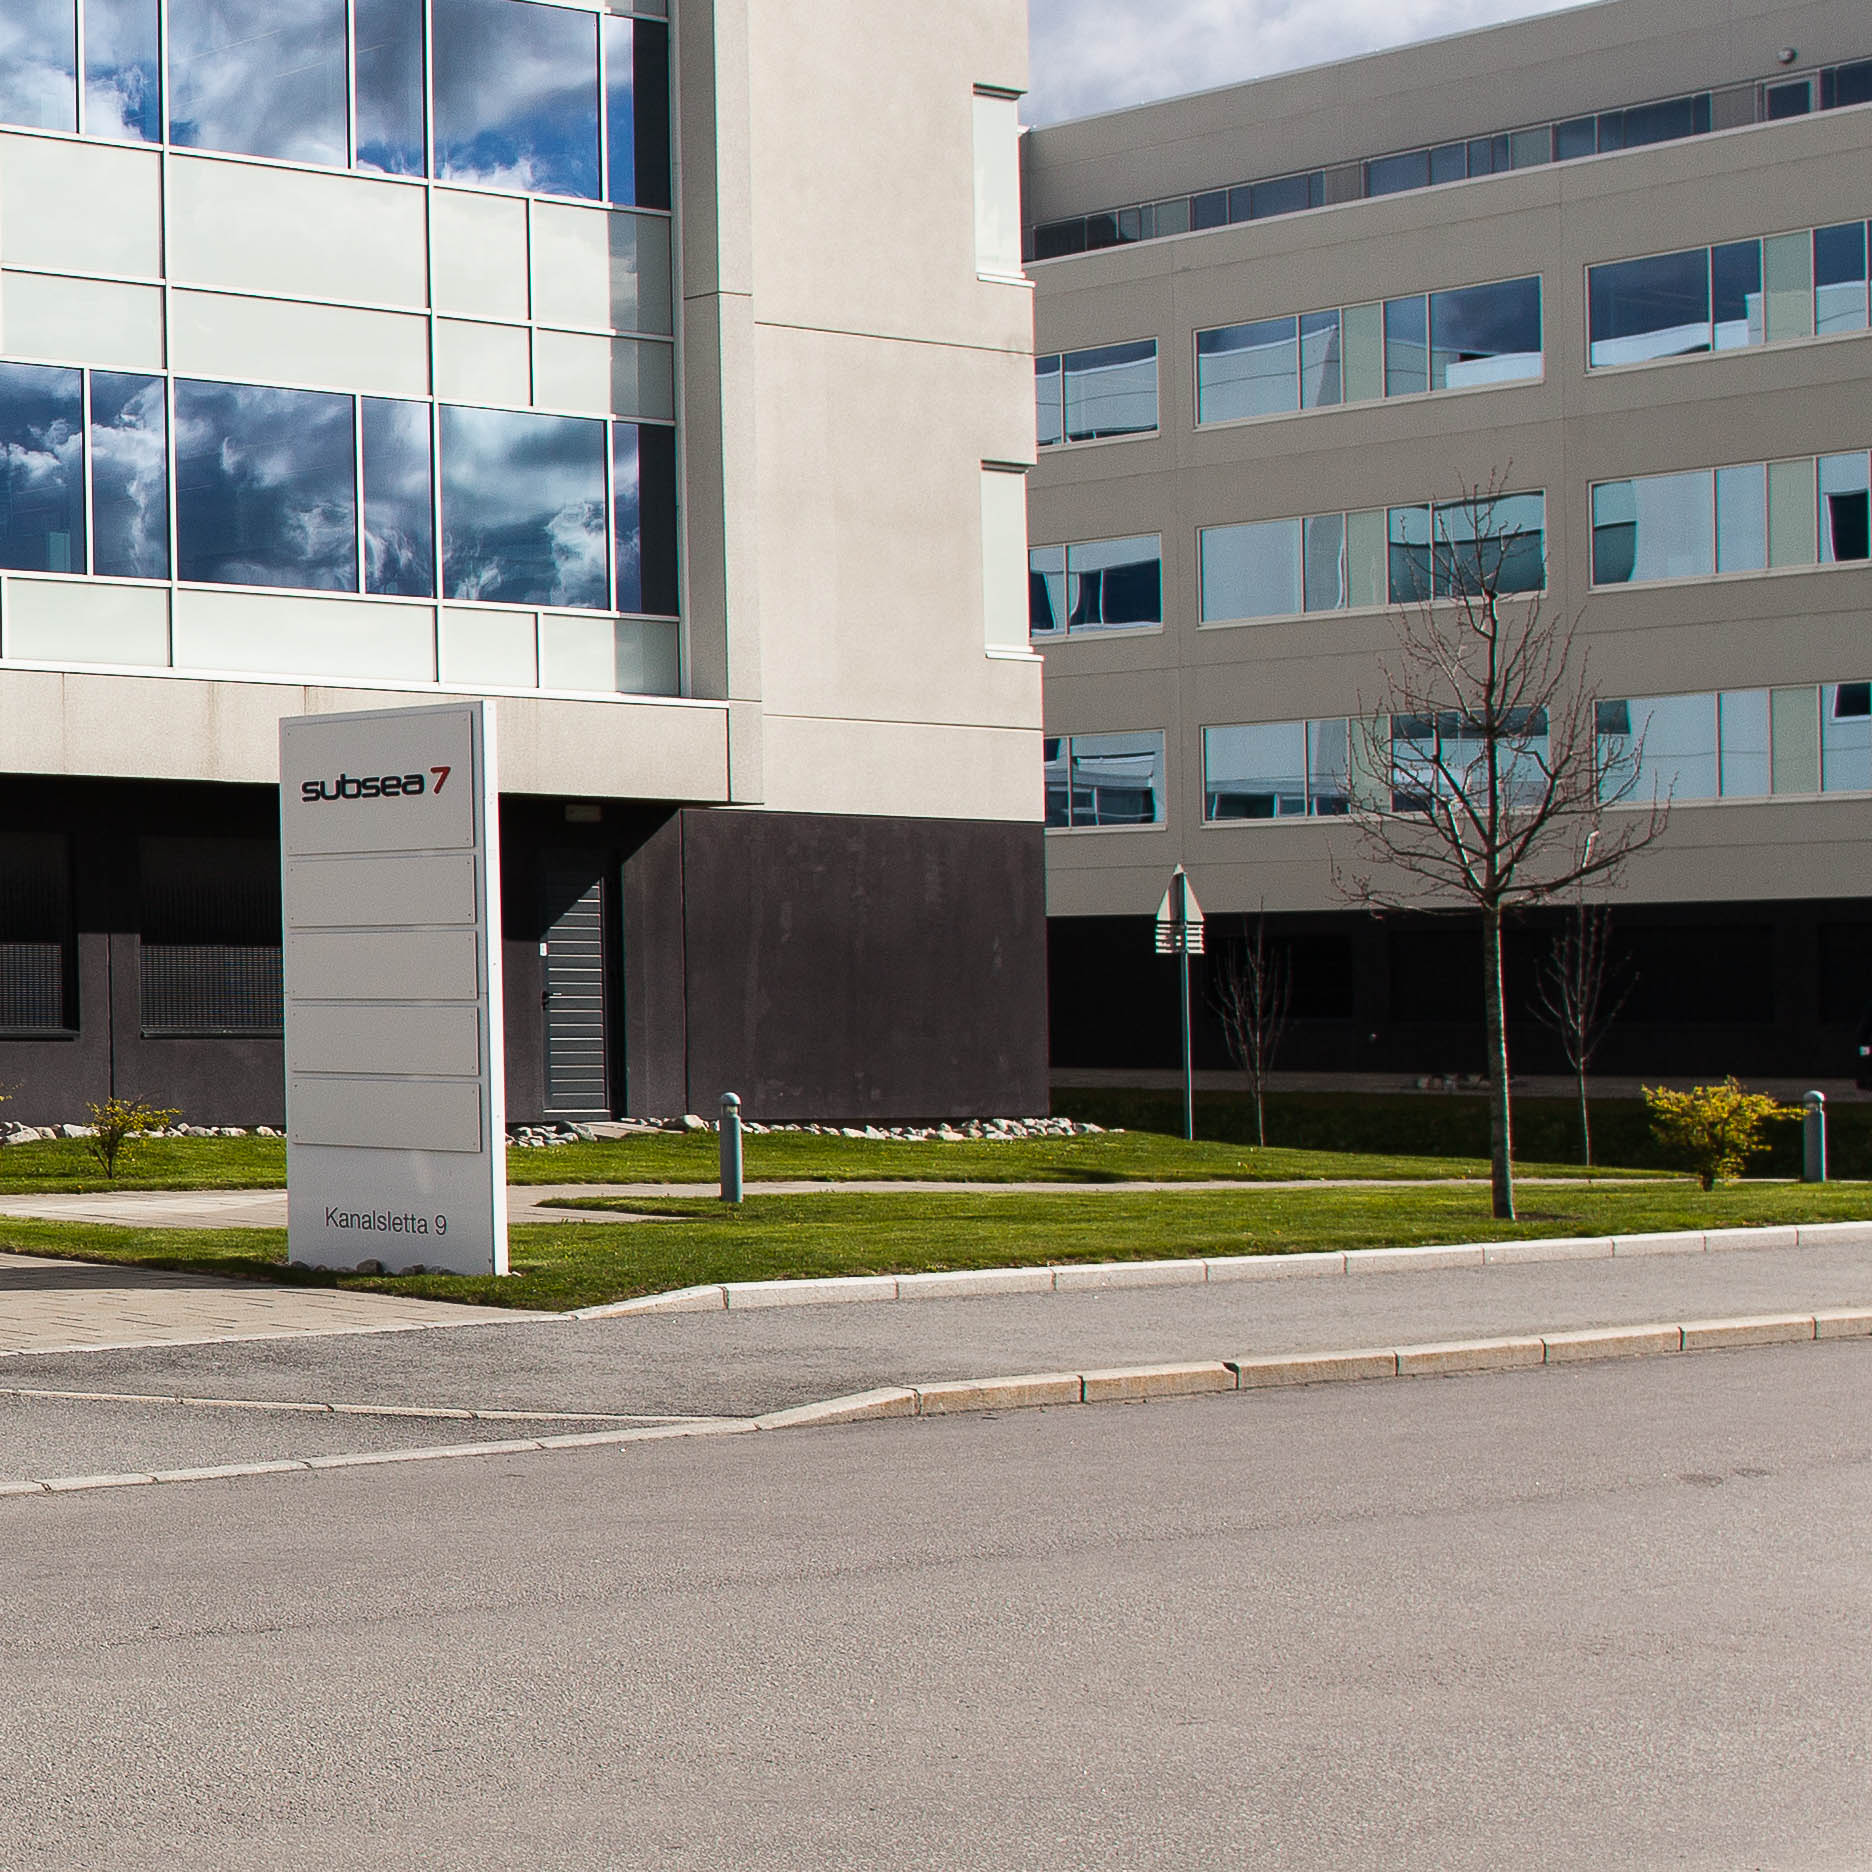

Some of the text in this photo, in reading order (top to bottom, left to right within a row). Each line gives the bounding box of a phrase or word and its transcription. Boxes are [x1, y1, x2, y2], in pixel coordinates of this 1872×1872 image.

[301, 766, 451, 802] subsea 7
[325, 1206, 447, 1235] Kanalsletta 9
